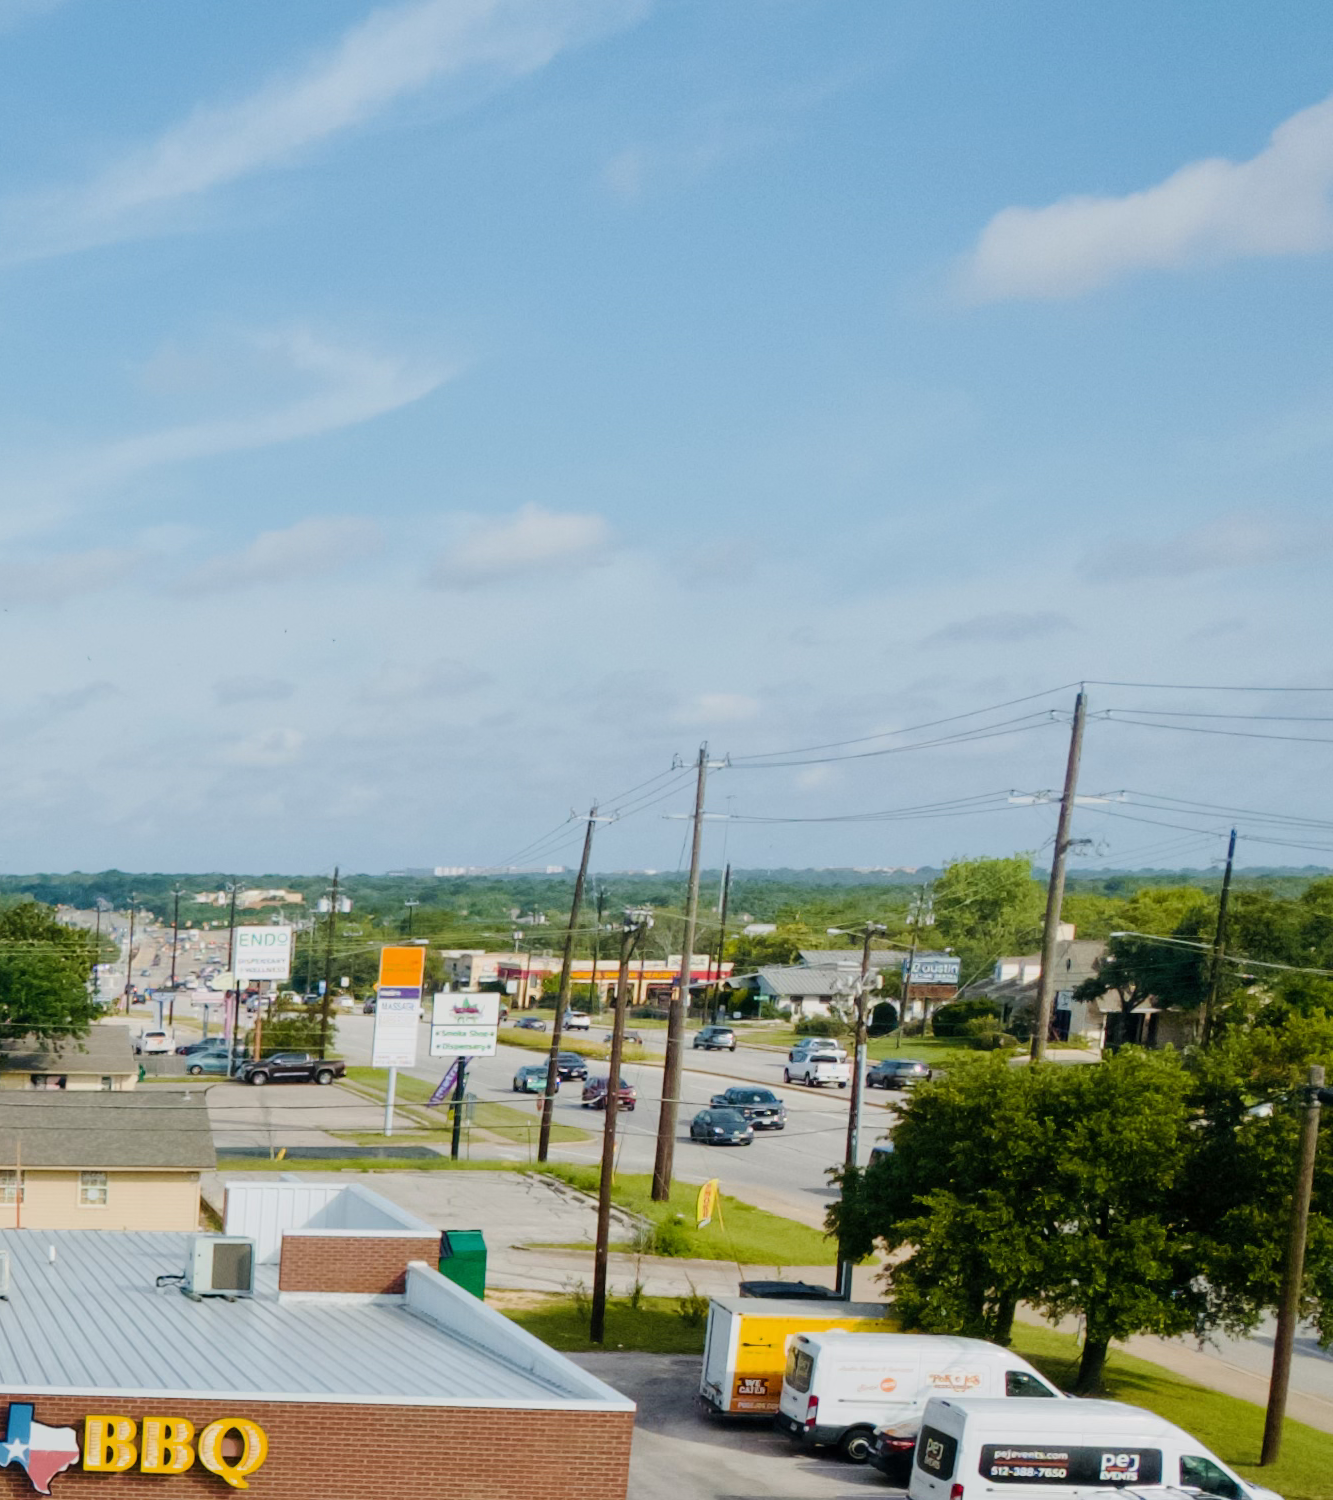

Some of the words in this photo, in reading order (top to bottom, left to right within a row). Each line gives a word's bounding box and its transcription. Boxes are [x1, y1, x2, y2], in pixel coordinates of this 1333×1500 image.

[239, 933, 288, 946] ENDO
[83, 1415, 270, 1489] BBQ
[994, 1449, 1069, 1460] pejevents.com
[1100, 1453, 1140, 1471] pej
[990, 1466, 1067, 1478] 512-388-7650
[1099, 1471, 1139, 1481] EVENTS
